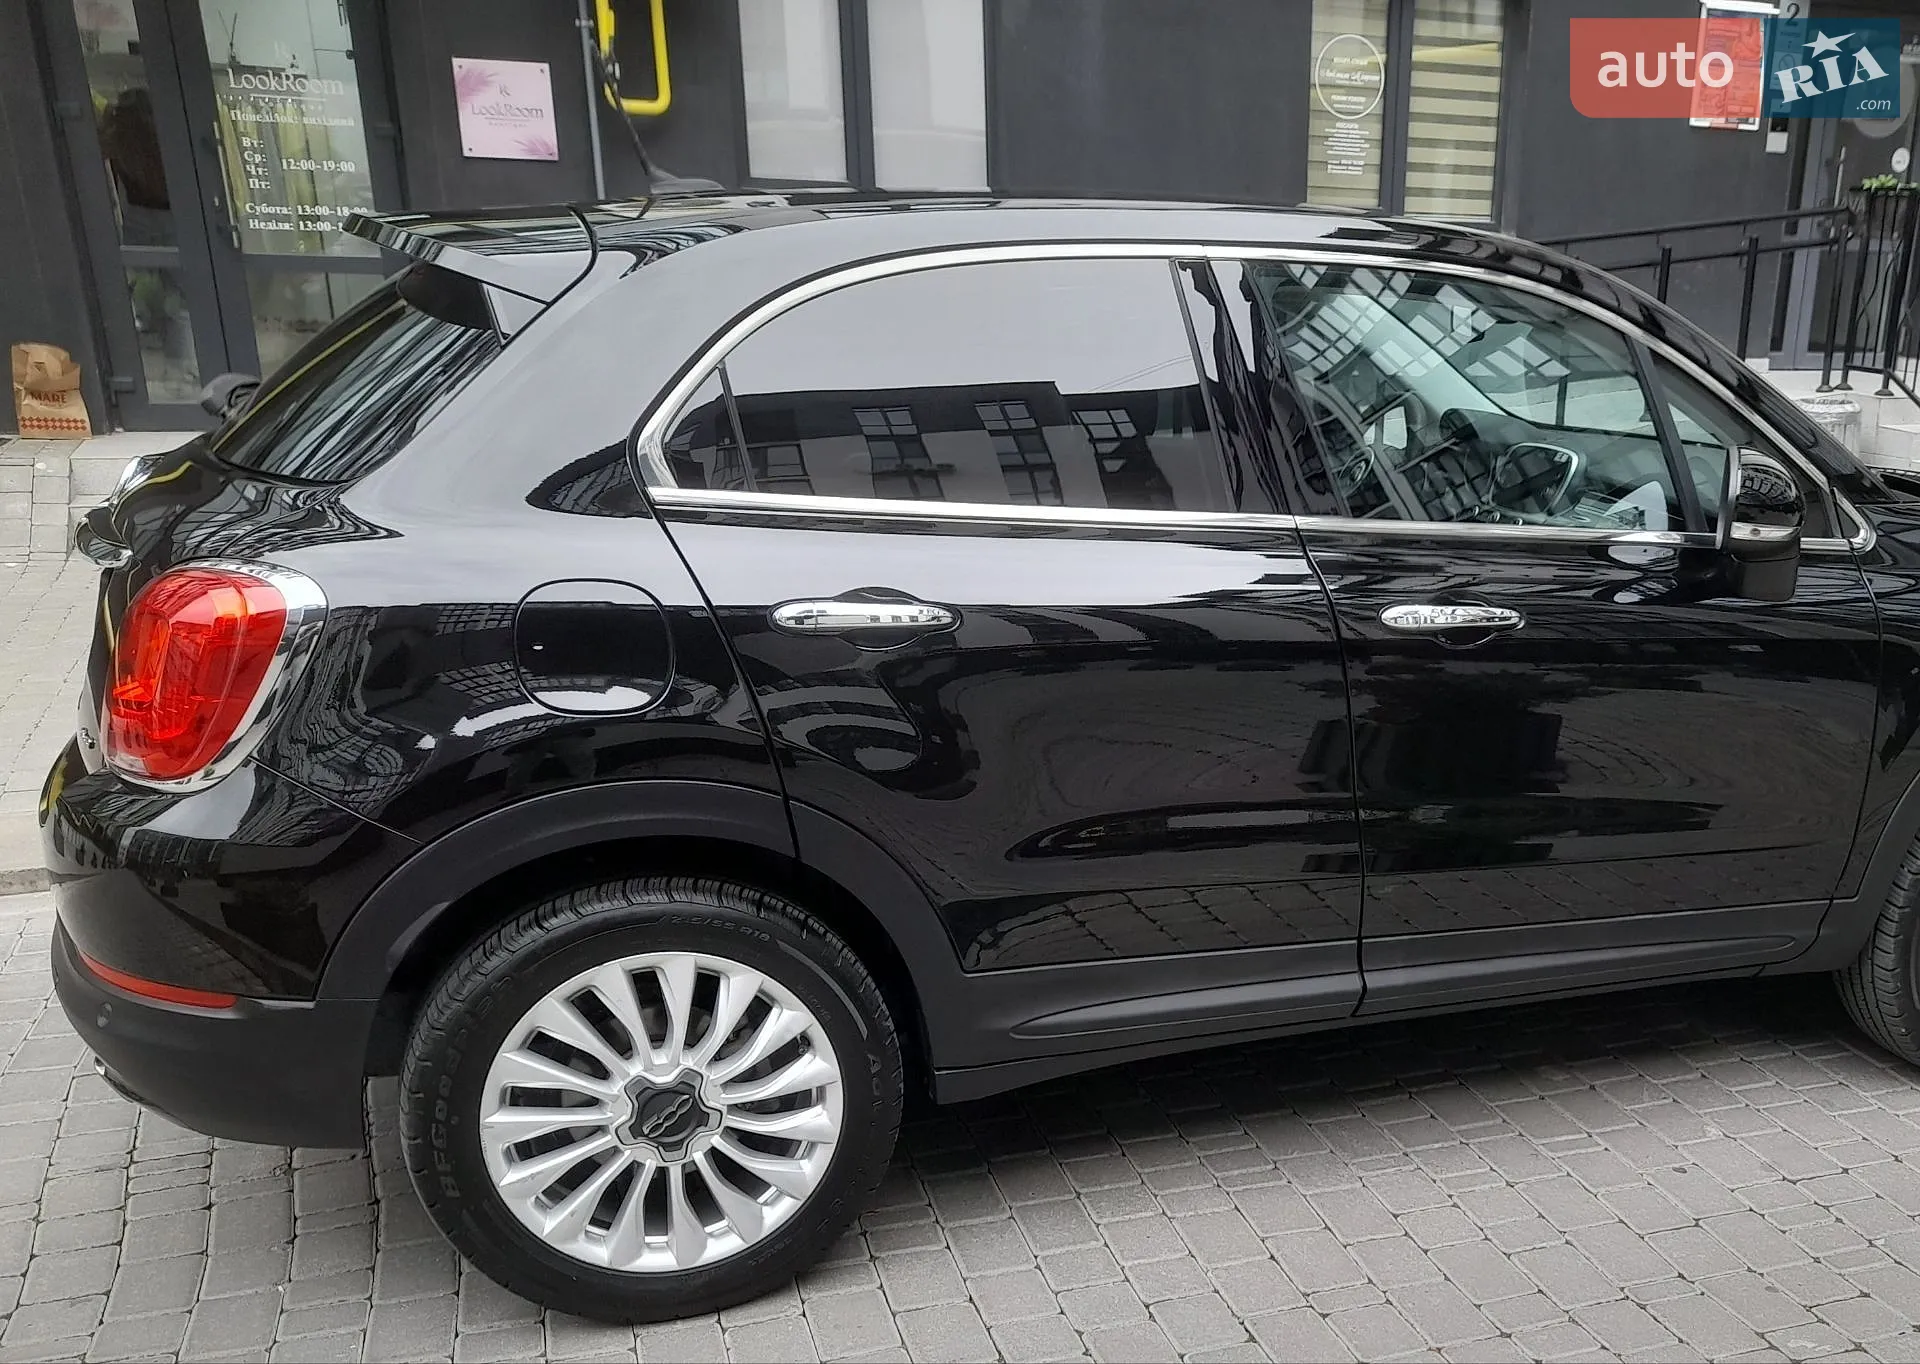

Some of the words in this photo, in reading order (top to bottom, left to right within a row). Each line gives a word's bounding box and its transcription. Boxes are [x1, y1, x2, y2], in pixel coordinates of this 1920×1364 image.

[1785, 3, 1800, 27] 2
[227, 68, 344, 96] LookRoom
[471, 101, 544, 121] LookRoom
[241, 136, 264, 148] Вт:
[244, 150, 267, 163] Ср:
[246, 164, 269, 176] Чт:
[281, 158, 356, 173] 12:00-19:00
[248, 178, 271, 189] Пт:
[245, 202, 292, 216] Субота:
[248, 218, 294, 231] Неділя:
[299, 220, 343, 233] 13:00-1
